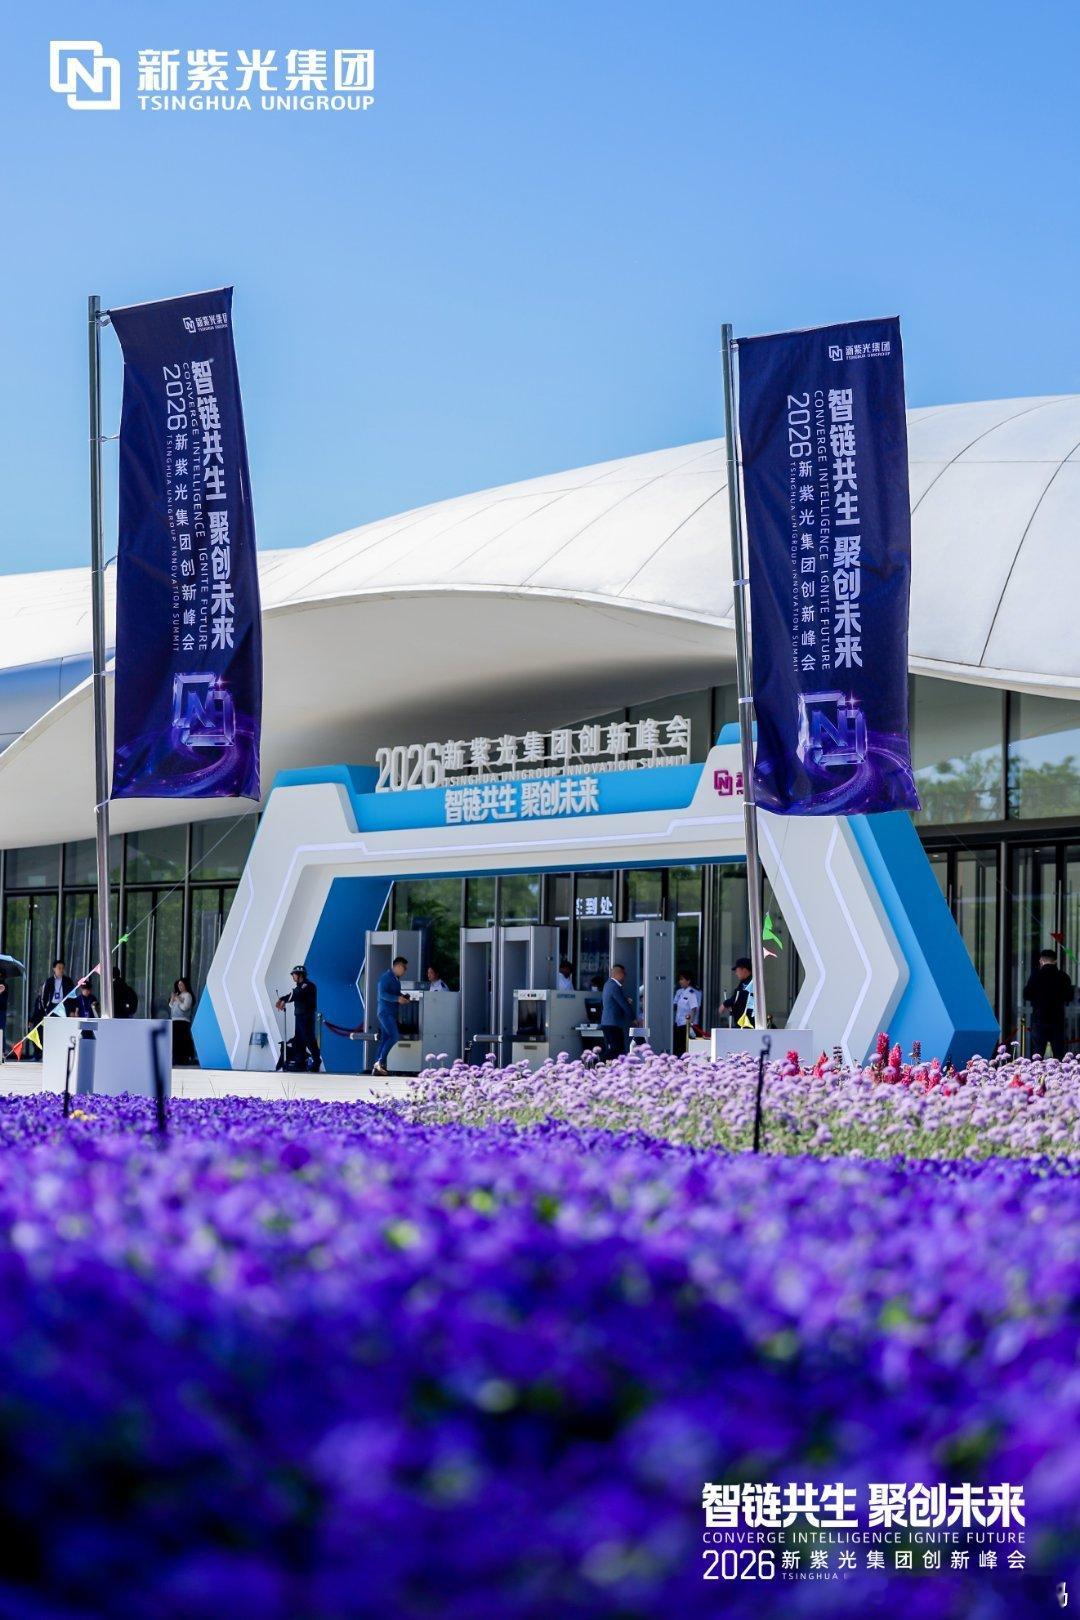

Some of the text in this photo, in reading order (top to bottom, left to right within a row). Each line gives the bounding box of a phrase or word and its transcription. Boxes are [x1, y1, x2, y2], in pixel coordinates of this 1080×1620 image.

[163, 363, 188, 431] 2026
[191, 360, 227, 500] 智链共生
[787, 392, 812, 458] 2026
[183, 362, 209, 651] CONVERGE INTELLIGENCE IGNITE FUTURE
[814, 390, 831, 670] CONVERGE INTELLIGENCE IGNITE FUTURE
[828, 388, 863, 669] 智链共生 聚创未来
[208, 510, 235, 650] 聚创未来
[375, 742, 443, 794] 2026
[445, 776, 600, 824] 智链共生 聚创未来
